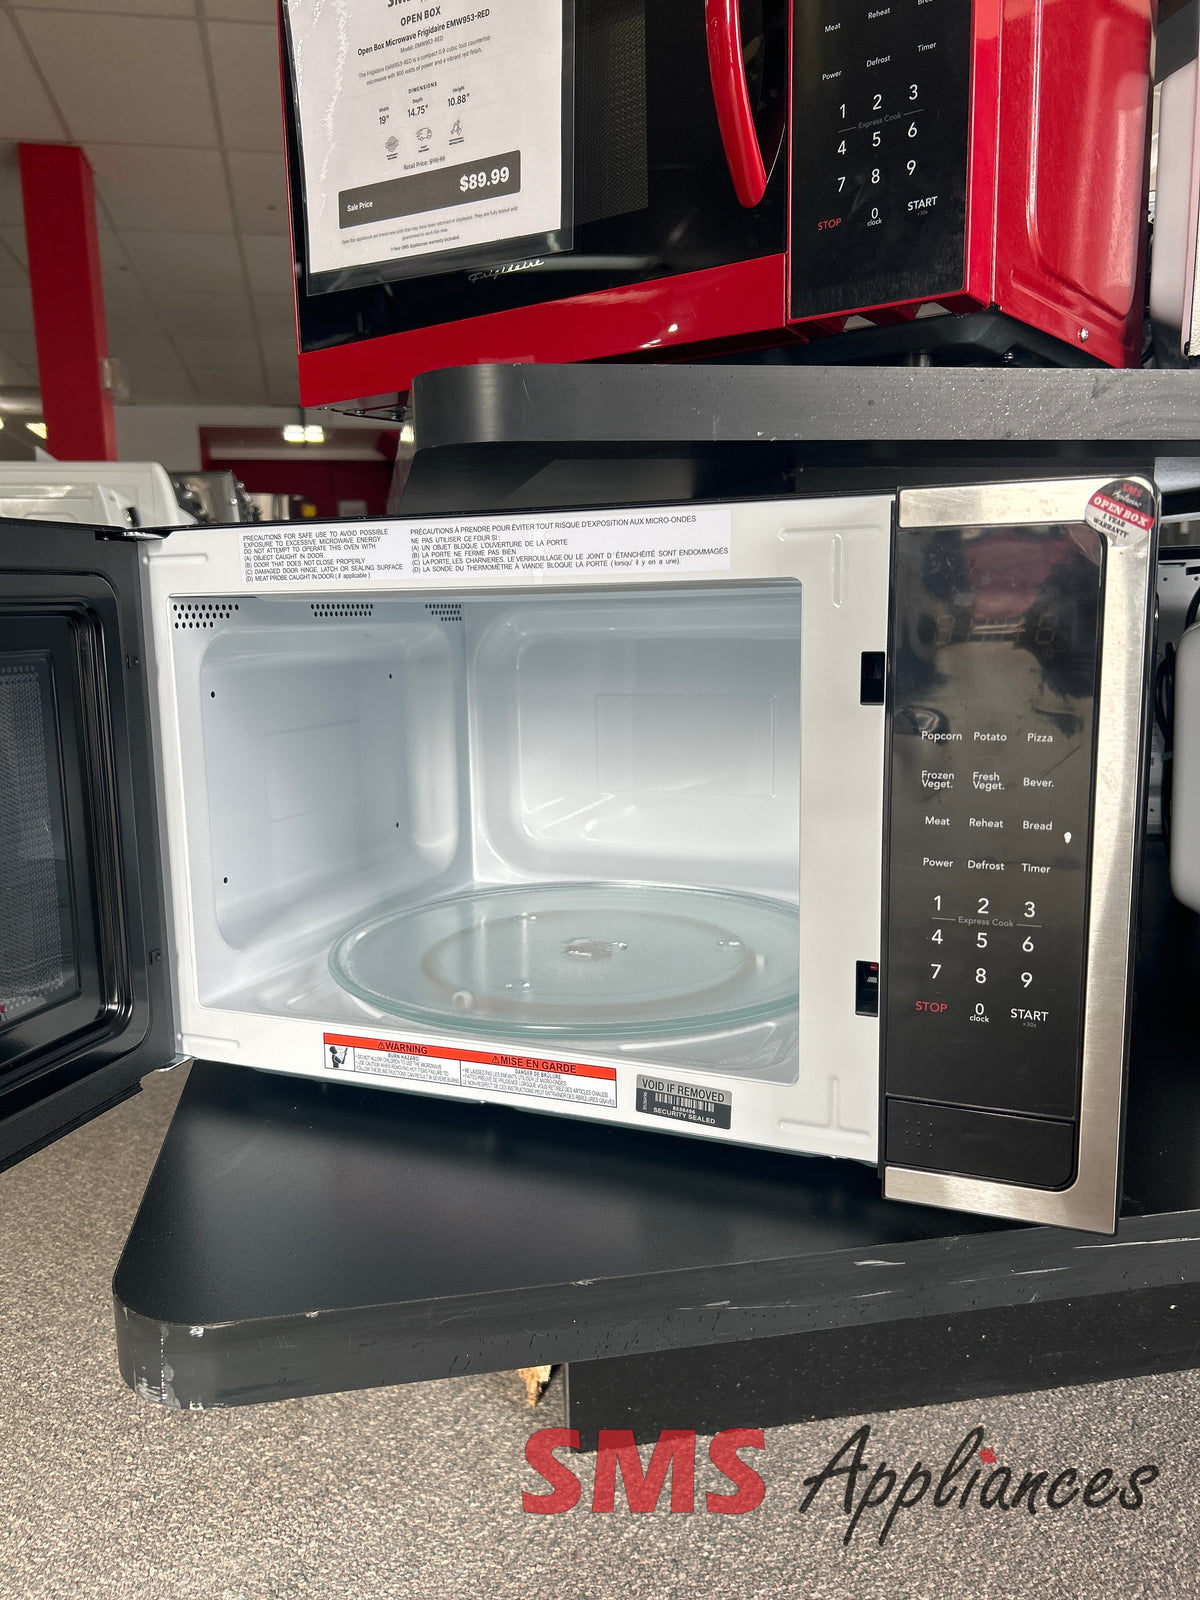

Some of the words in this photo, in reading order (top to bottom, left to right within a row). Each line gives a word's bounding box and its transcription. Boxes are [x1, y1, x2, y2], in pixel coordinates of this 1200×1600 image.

[400, 13, 422, 26] OPEN
[423, 6, 441, 21] BOX
[868, 7, 891, 20] Reheat
[357, 45, 373, 56] Open
[374, 43, 384, 52] Box
[385, 33, 417, 48] Microwave
[417, 24, 445, 39] Frigidaire
[446, 9, 490, 29] EMW953-RED
[824, 23, 841, 32] Meat
[917, 42, 937, 52] Timer
[866, 55, 891, 68] Defrost
[822, 70, 842, 81] Power
[408, 82, 437, 94] DIMENSIONS
[909, 84, 918, 100] 3
[447, 93, 470, 107] 10.88"
[872, 94, 882, 110] 2
[407, 104, 429, 118] 14.75"
[839, 104, 846, 119] 1
[379, 114, 390, 125] 19"
[858, 117, 883, 129] Express
[884, 113, 901, 123] Cook
[907, 122, 918, 138] 6
[872, 131, 881, 147] 5
[837, 140, 846, 155] 4
[403, 161, 416, 170] Retail
[906, 159, 916, 176] 9
[459, 166, 510, 193] $89.99
[871, 168, 880, 184] 8
[837, 176, 846, 192] 7
[347, 203, 359, 213] Sale
[359, 201, 374, 210] Price
[907, 196, 938, 212] START
[871, 207, 879, 219] 0
[817, 217, 842, 231] STOP
[866, 218, 882, 227] clock
[468, 259, 544, 284] Frigidaire
[1093, 497, 1123, 515] OPEN
[1123, 508, 1149, 527] BOX
[410, 527, 453, 535] PRÉCAUTIONS
[460, 525, 490, 533] PRENDRE
[512, 523, 535, 531] ÉVITER
[536, 522, 554, 530] TOUT
[555, 521, 580, 529] RISQUE
[581, 519, 628, 528] D'EXPOSITION
[645, 515, 696, 525] MICRO-ONDES
[1093, 517, 1129, 538] WARRANTY
[1108, 516, 1126, 527] YEAR
[243, 533, 282, 541] PRECAUTIONS
[359, 528, 388, 536] POSSIBLE
[319, 537, 354, 545] MICROWAVE
[480, 541, 522, 549] L'OUVERTURE
[316, 558, 334, 566] CLOSE
[921, 731, 962, 743] Popcorn
[973, 731, 1007, 742] Potato
[1027, 732, 1053, 743] Pizza
[921, 770, 955, 780] Frozen
[972, 771, 999, 781] Fresh
[921, 779, 953, 790] Veget.
[972, 780, 1005, 792] Veget.
[1023, 777, 1054, 788] Bever.
[925, 816, 950, 826] Meat
[969, 818, 1003, 828] Reheat
[1023, 820, 1052, 831] Bread
[923, 857, 953, 868] Power
[968, 860, 1005, 871] Defrost
[1022, 863, 1051, 874] Timer
[934, 895, 941, 911] 1
[978, 898, 989, 914] 2
[1024, 901, 1036, 918] 3
[958, 915, 990, 926] Express
[992, 918, 1014, 927] Cook
[931, 929, 943, 945] 4
[976, 932, 988, 948] 5
[1022, 936, 1034, 952] 6
[931, 963, 942, 979] 7
[975, 968, 987, 984] 8
[1021, 972, 1033, 988] 9
[915, 1001, 948, 1012] STOP
[975, 1003, 984, 1015] 0
[969, 1015, 989, 1023] clock
[1010, 1008, 1049, 1022] START
[386, 1042, 428, 1055] WARNING
[388, 1052, 400, 1060] BURN
[401, 1054, 420, 1062] HAZARD
[501, 1056, 523, 1067] MISE
[526, 1058, 539, 1069] EN
[542, 1060, 576, 1074] GARDE
[643, 1079, 664, 1091] VOID
[667, 1083, 675, 1093] IF
[677, 1085, 724, 1102] REMOVED
[653, 1107, 687, 1119] SECURITY
[687, 1114, 716, 1124] SEALED
